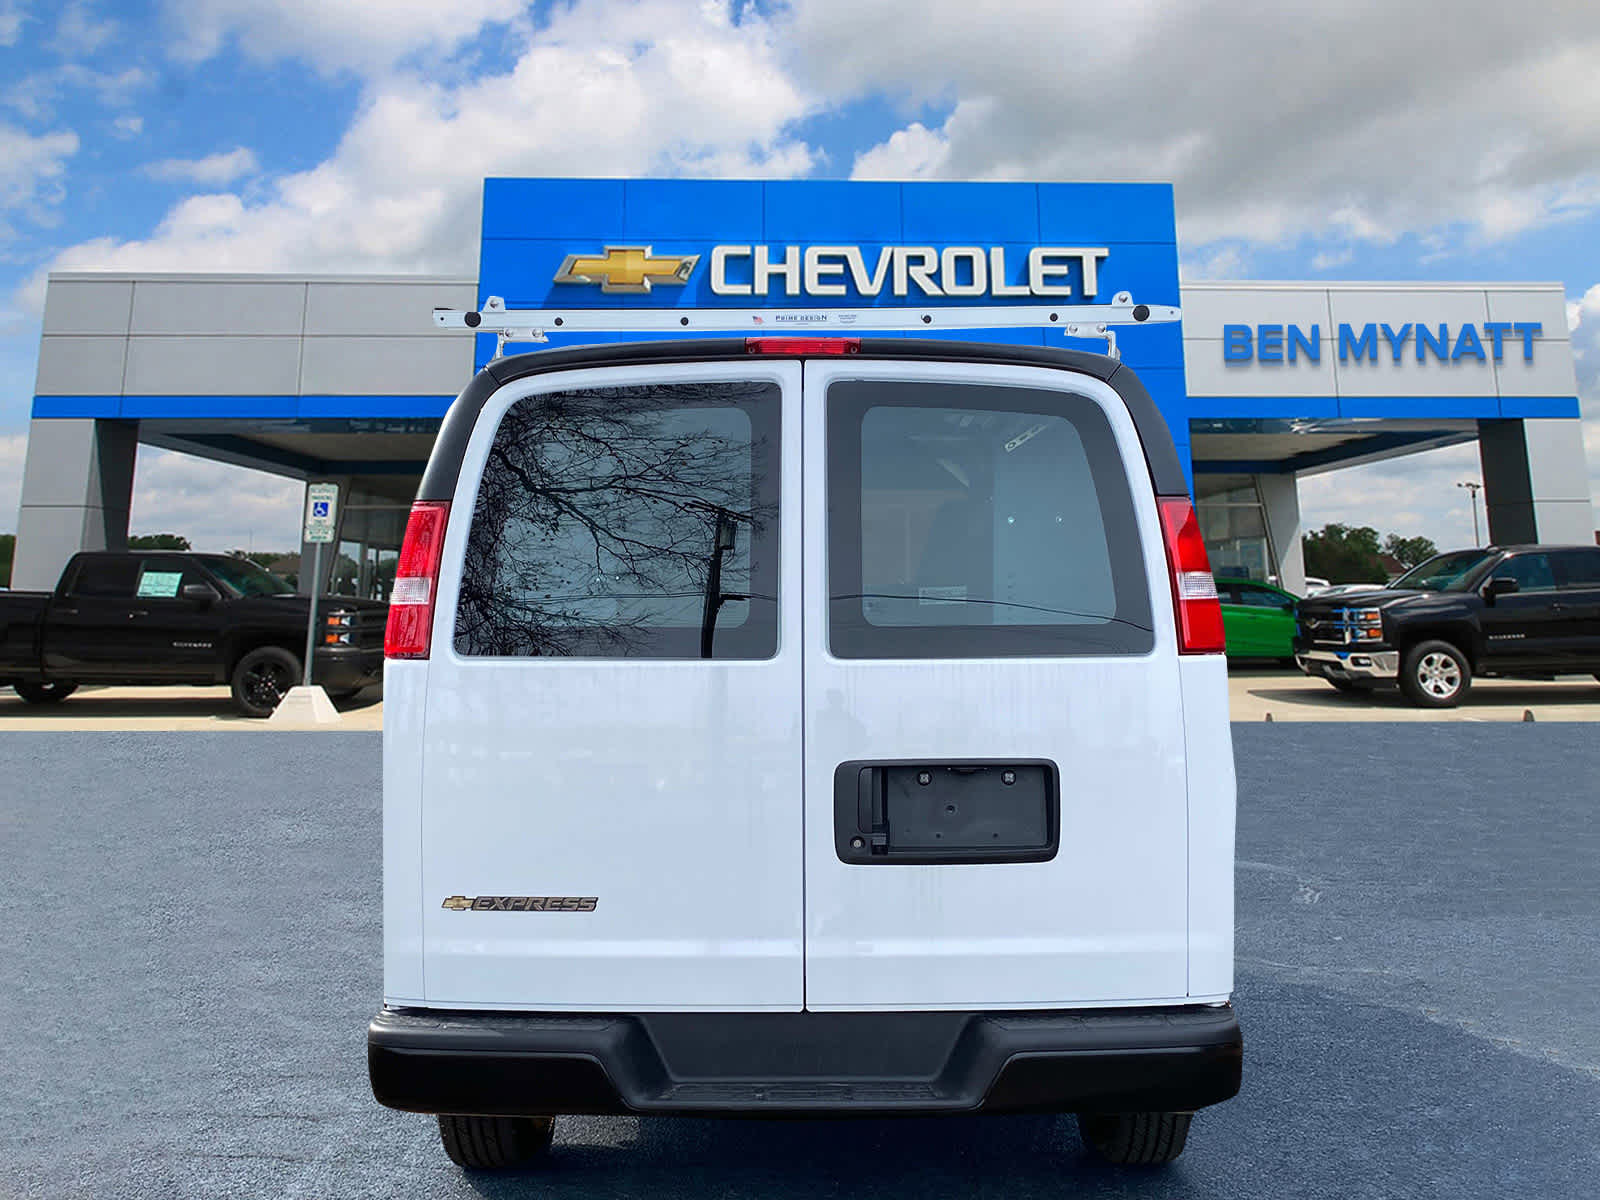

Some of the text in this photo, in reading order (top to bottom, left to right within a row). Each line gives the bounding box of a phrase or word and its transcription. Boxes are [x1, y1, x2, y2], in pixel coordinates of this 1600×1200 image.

[710, 245, 1110, 297] CHEVROLET
[1223, 322, 1542, 362] BEN MYNATT
[472, 896, 598, 912] EXPRESS
